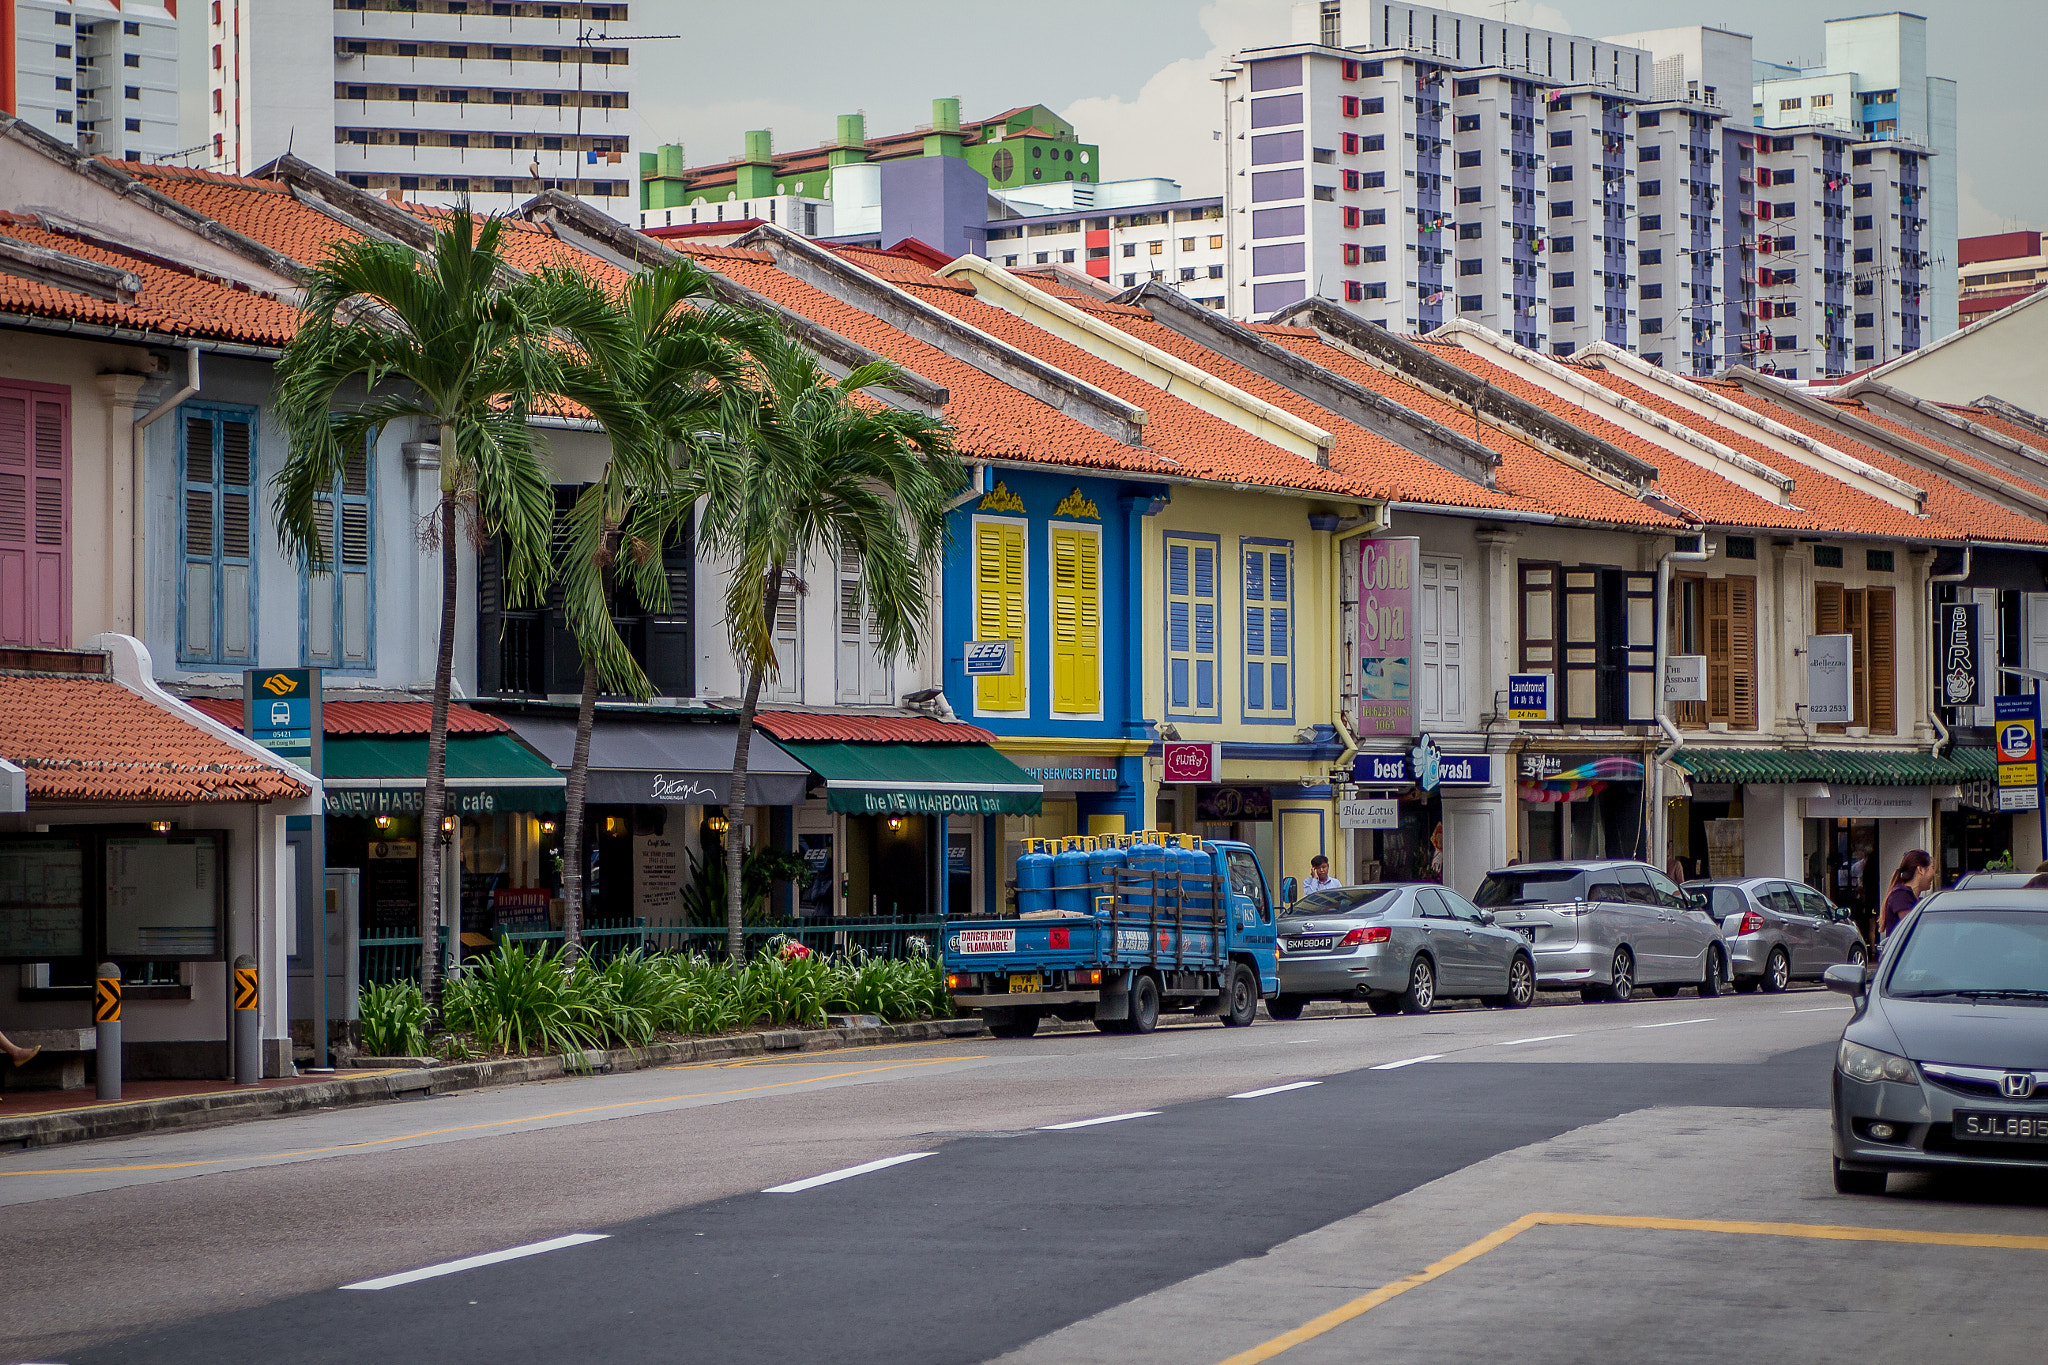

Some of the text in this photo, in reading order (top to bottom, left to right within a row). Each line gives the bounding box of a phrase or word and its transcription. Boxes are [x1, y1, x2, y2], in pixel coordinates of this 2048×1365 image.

[1362, 544, 1409, 590] Cola
[1366, 595, 1405, 651] Spa
[1948, 606, 1972, 670] SUPER
[969, 644, 1006, 658] EES
[1511, 681, 1544, 692] Laundromat
[1376, 719, 1395, 730] 106A
[2007, 727, 2028, 749] P
[1022, 768, 1117, 780] GHT SERVICES PTE LTD
[1373, 758, 1404, 778] best
[1438, 759, 1471, 779] wash
[340, 792, 375, 810] NEW
[380, 792, 457, 810] HARBR
[462, 792, 493, 810] cafe
[865, 793, 1000, 811] the NEW HARBOUR bar
[1960, 780, 1991, 811] UPER
[1343, 803, 1394, 815] Blue Lotus
[804, 849, 828, 860] EES
[499, 894, 544, 906] HAPPY HOUR
[962, 931, 1014, 941] DANGER HIGHLY
[967, 942, 1008, 952] FLAMMABLE
[1288, 939, 1331, 948] SKM9804P
[1967, 1117, 2048, 1136] SJL8815
